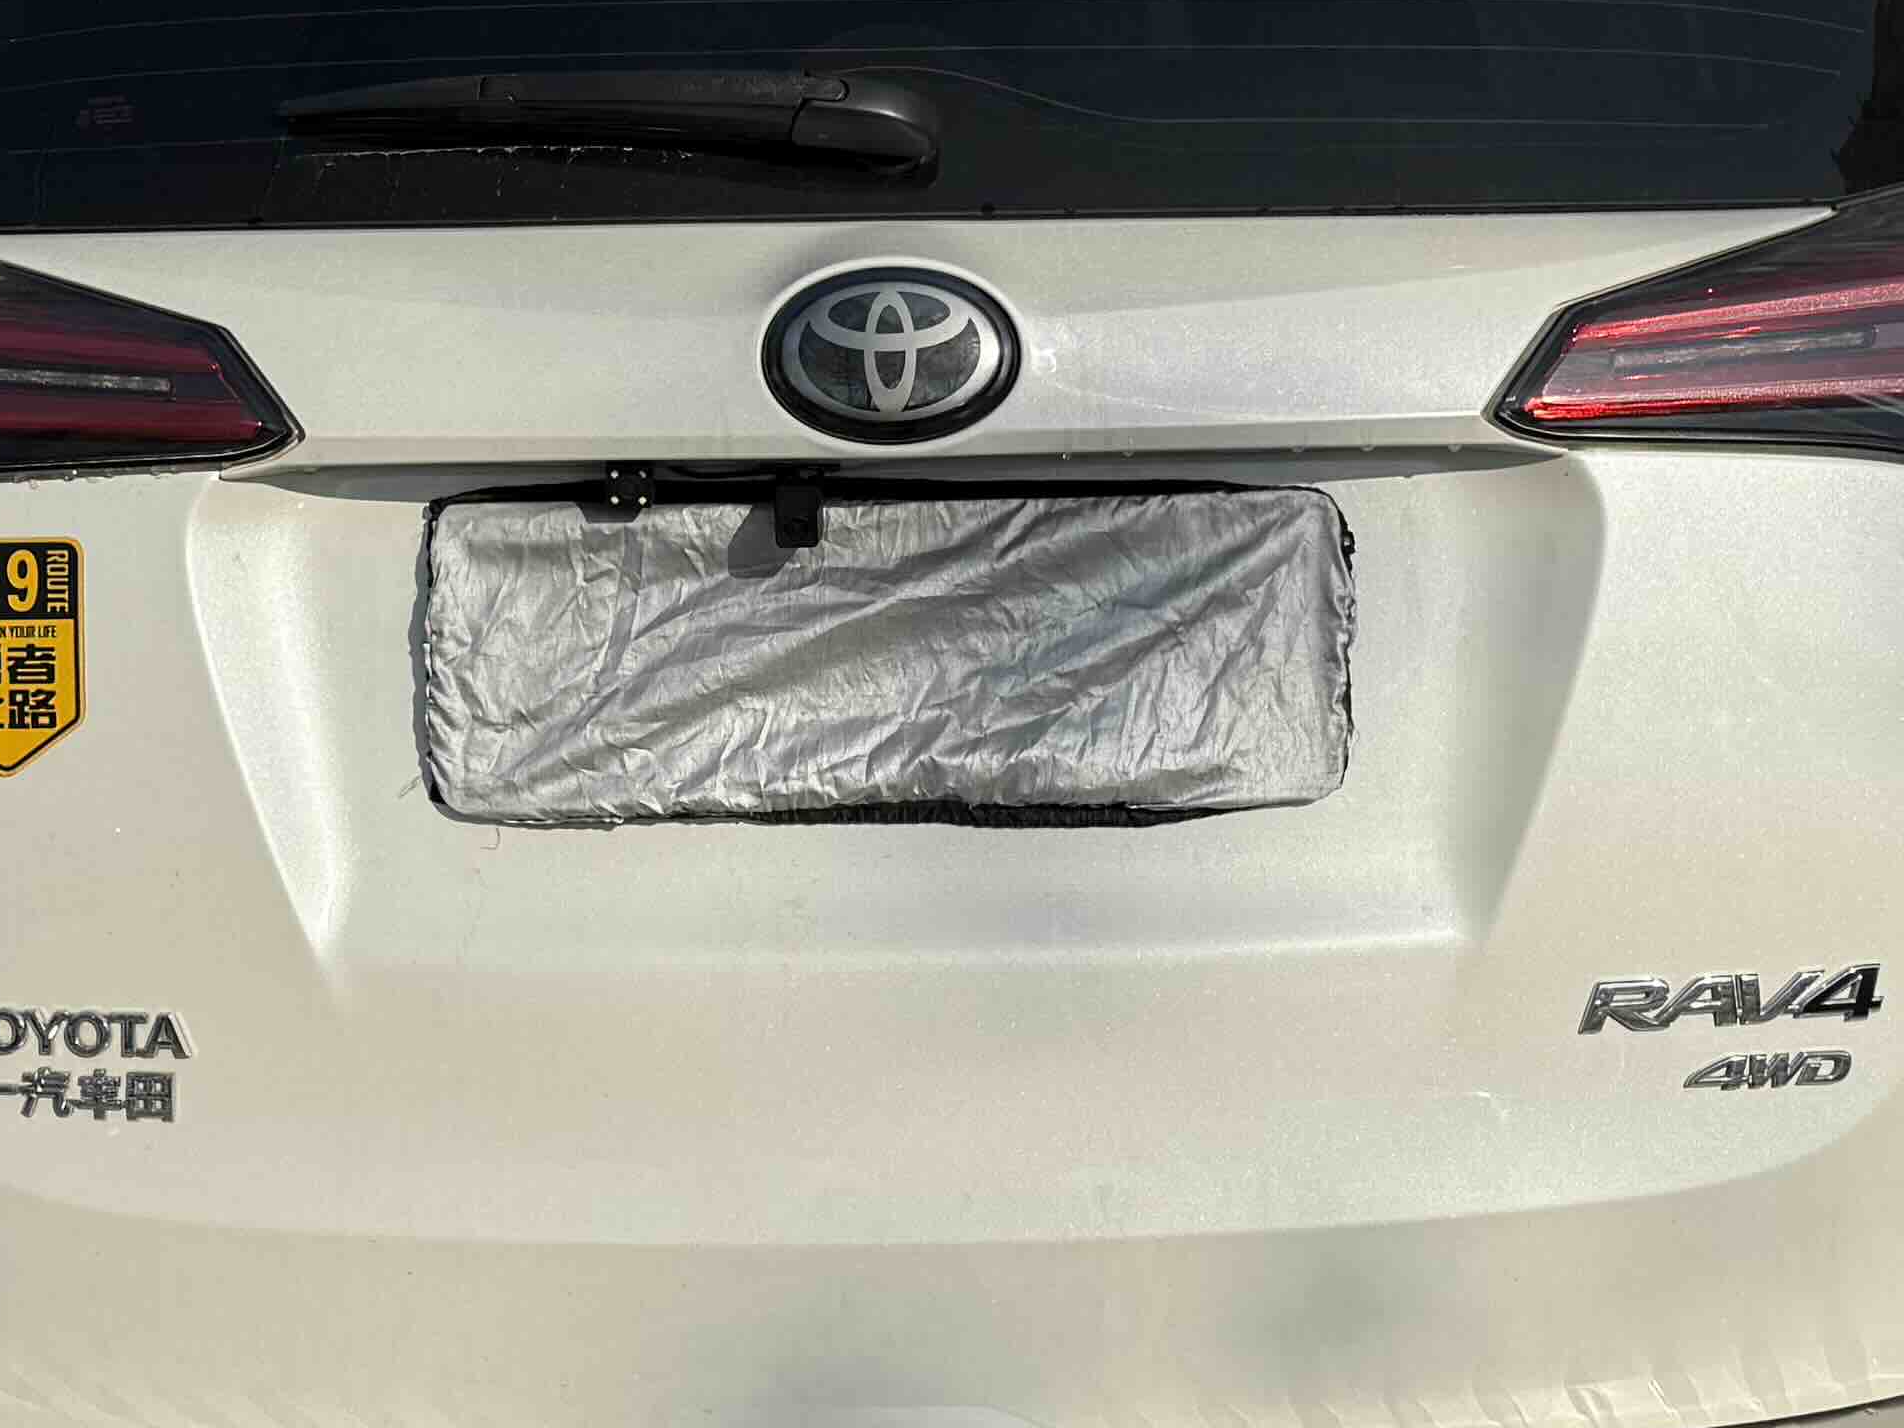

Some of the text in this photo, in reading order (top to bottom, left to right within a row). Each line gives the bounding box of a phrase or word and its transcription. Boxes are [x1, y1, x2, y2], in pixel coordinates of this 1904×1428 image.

[46, 549, 69, 613] ROUTE
[1577, 961, 1885, 1036] RAV4
[1682, 1049, 1853, 1091] 4WD
